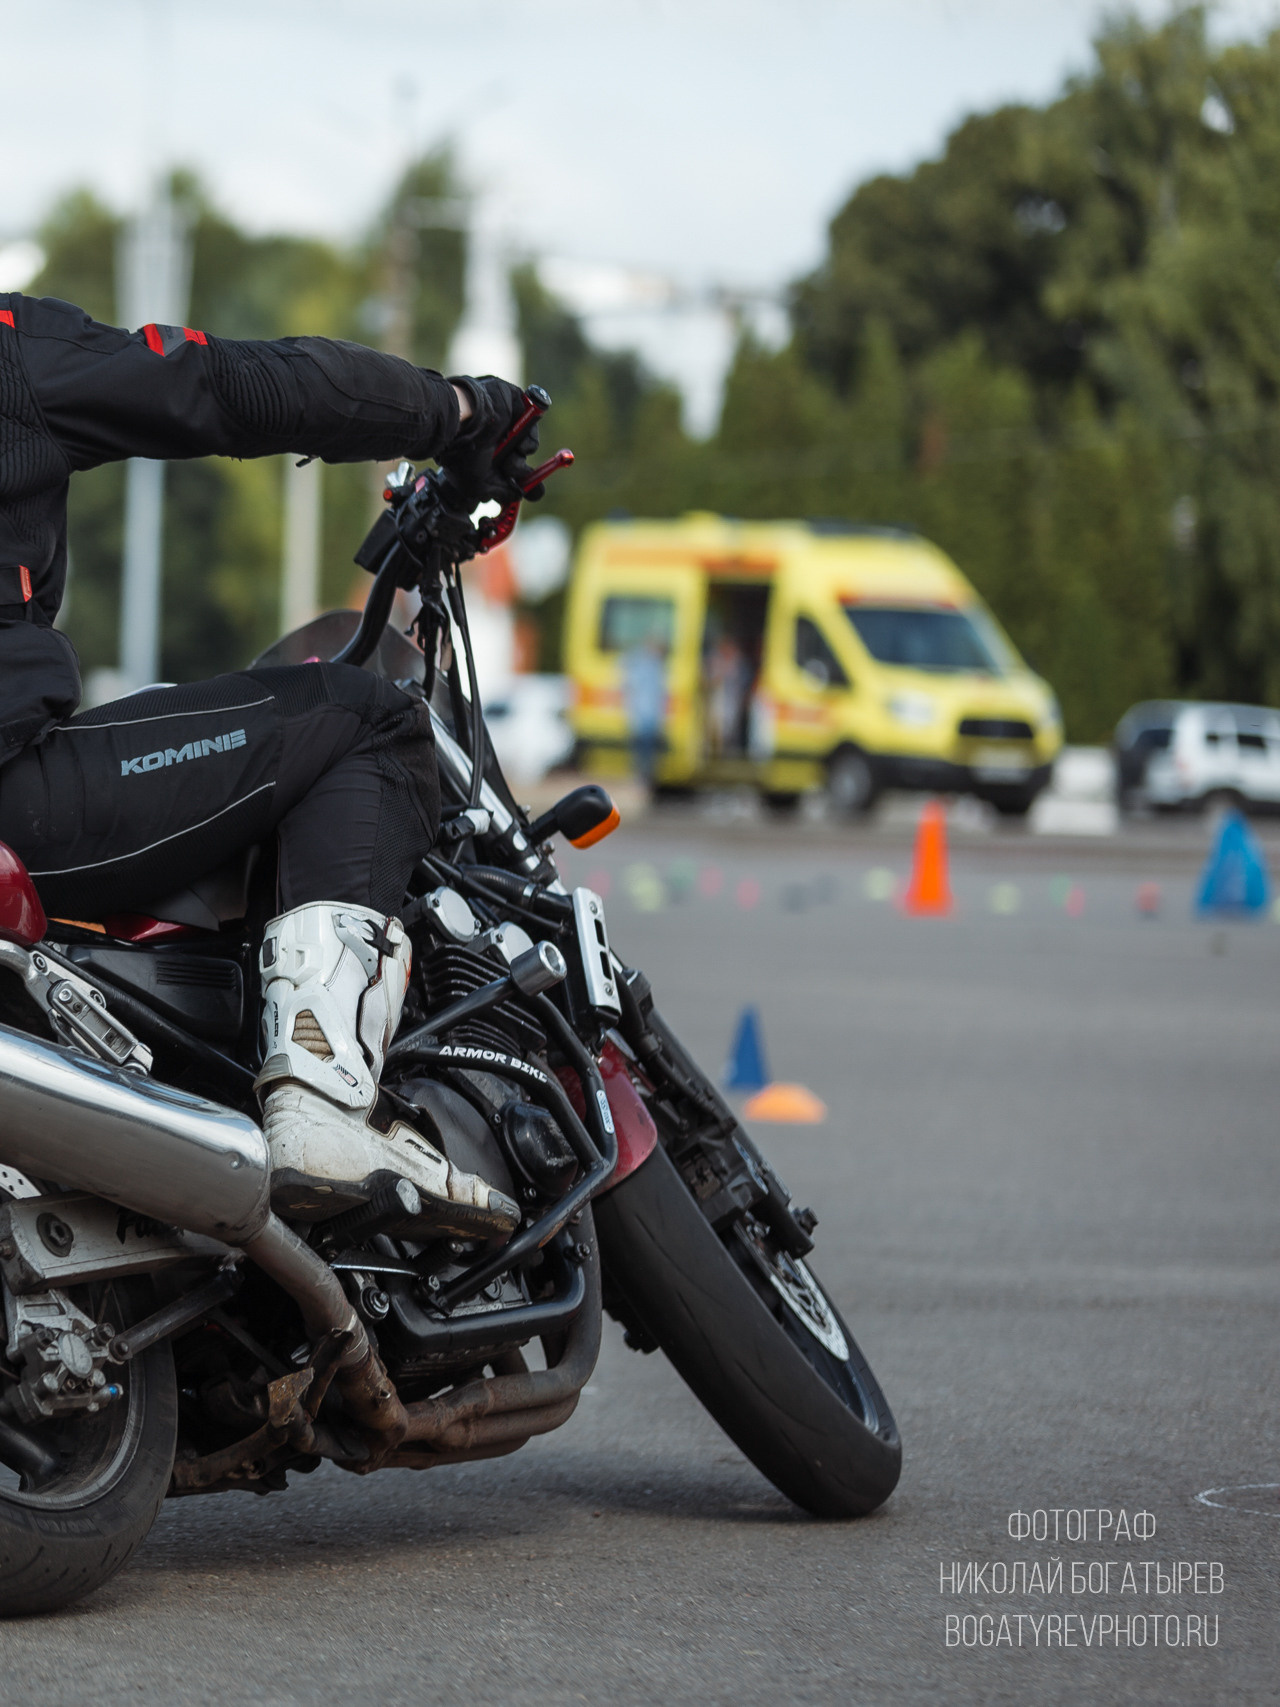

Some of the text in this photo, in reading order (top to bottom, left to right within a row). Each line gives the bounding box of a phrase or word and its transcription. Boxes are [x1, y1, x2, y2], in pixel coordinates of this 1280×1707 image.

[120, 728, 247, 777] KOMINE
[439, 1045, 548, 1083] ARMOR BIKE
